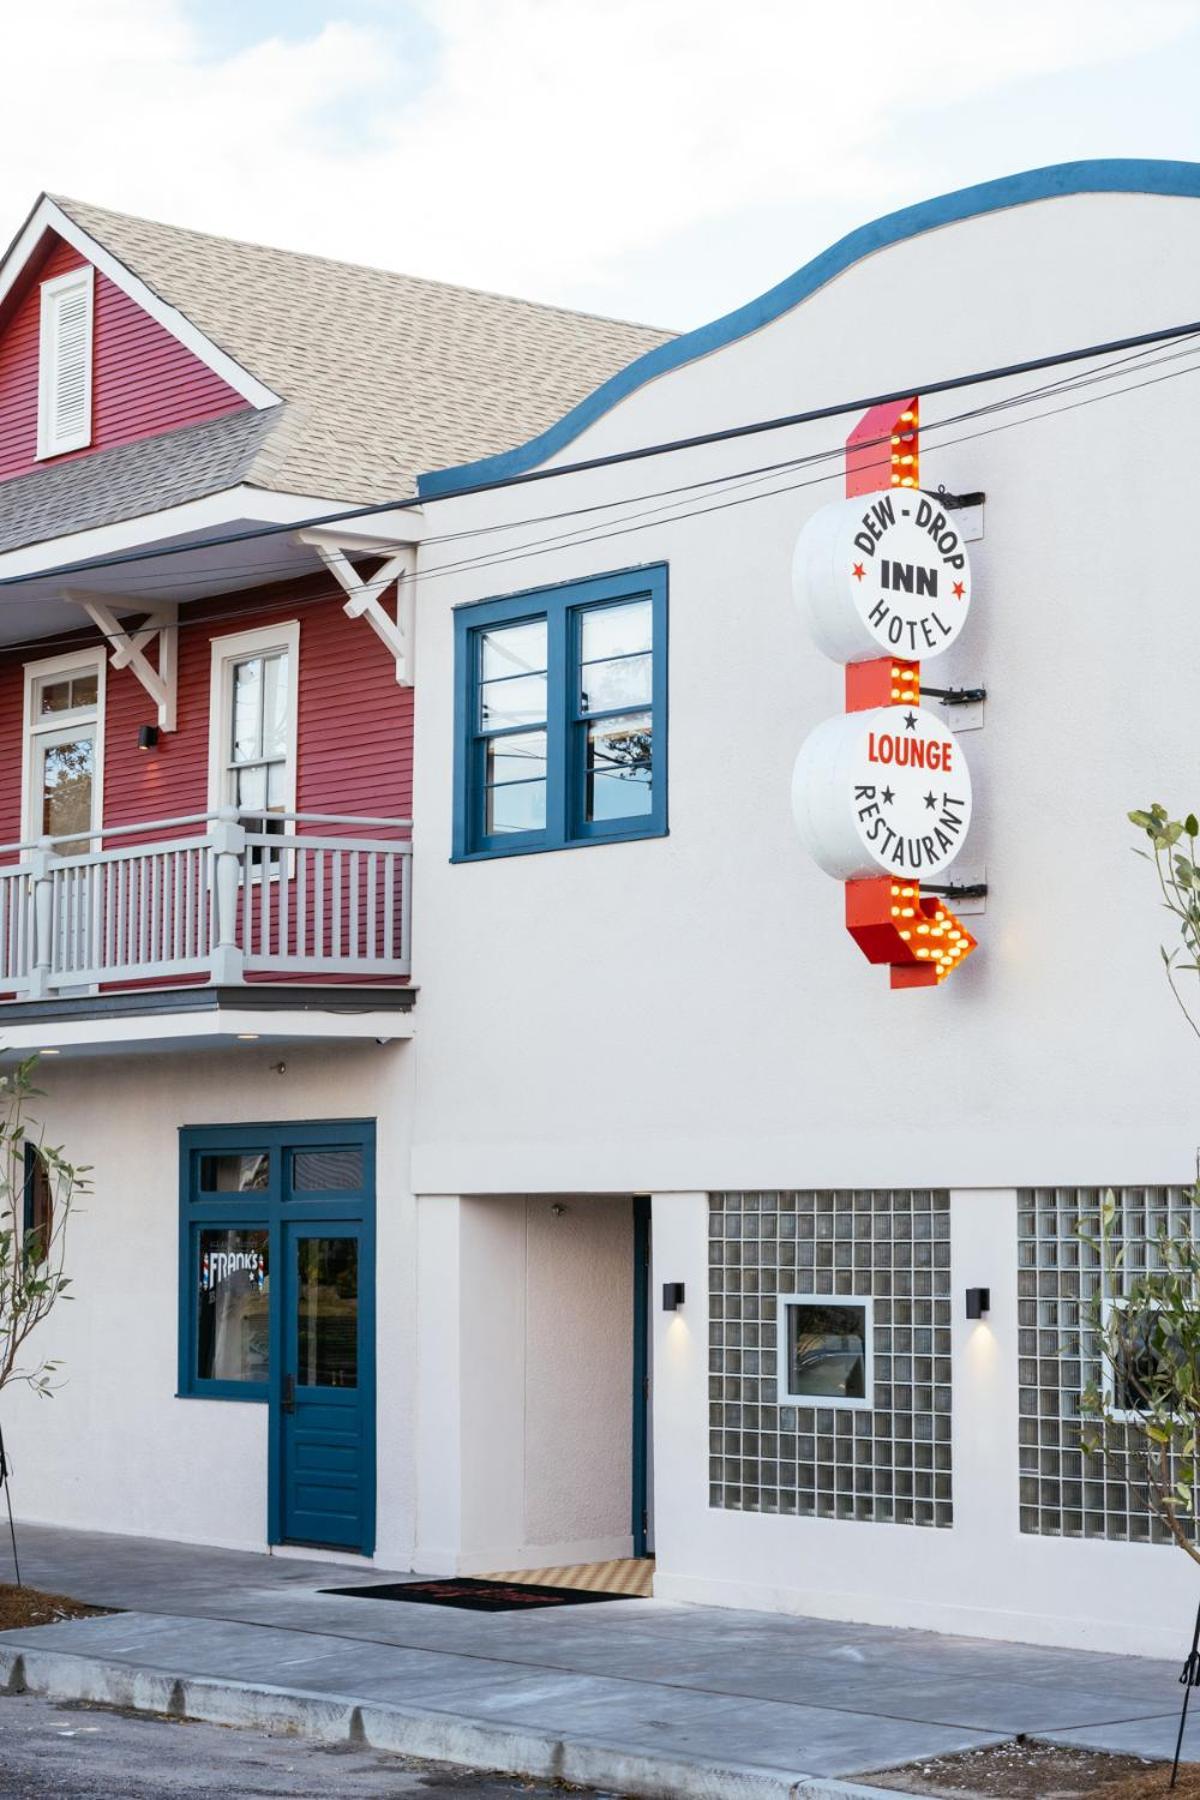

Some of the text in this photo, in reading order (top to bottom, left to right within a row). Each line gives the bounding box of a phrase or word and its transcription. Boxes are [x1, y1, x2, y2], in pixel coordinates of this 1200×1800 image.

[881, 559, 938, 598] INN
[868, 599, 952, 650] HOTEL
[868, 732, 952, 772] LOUNGE
[854, 785, 965, 868] RESTAURANT
